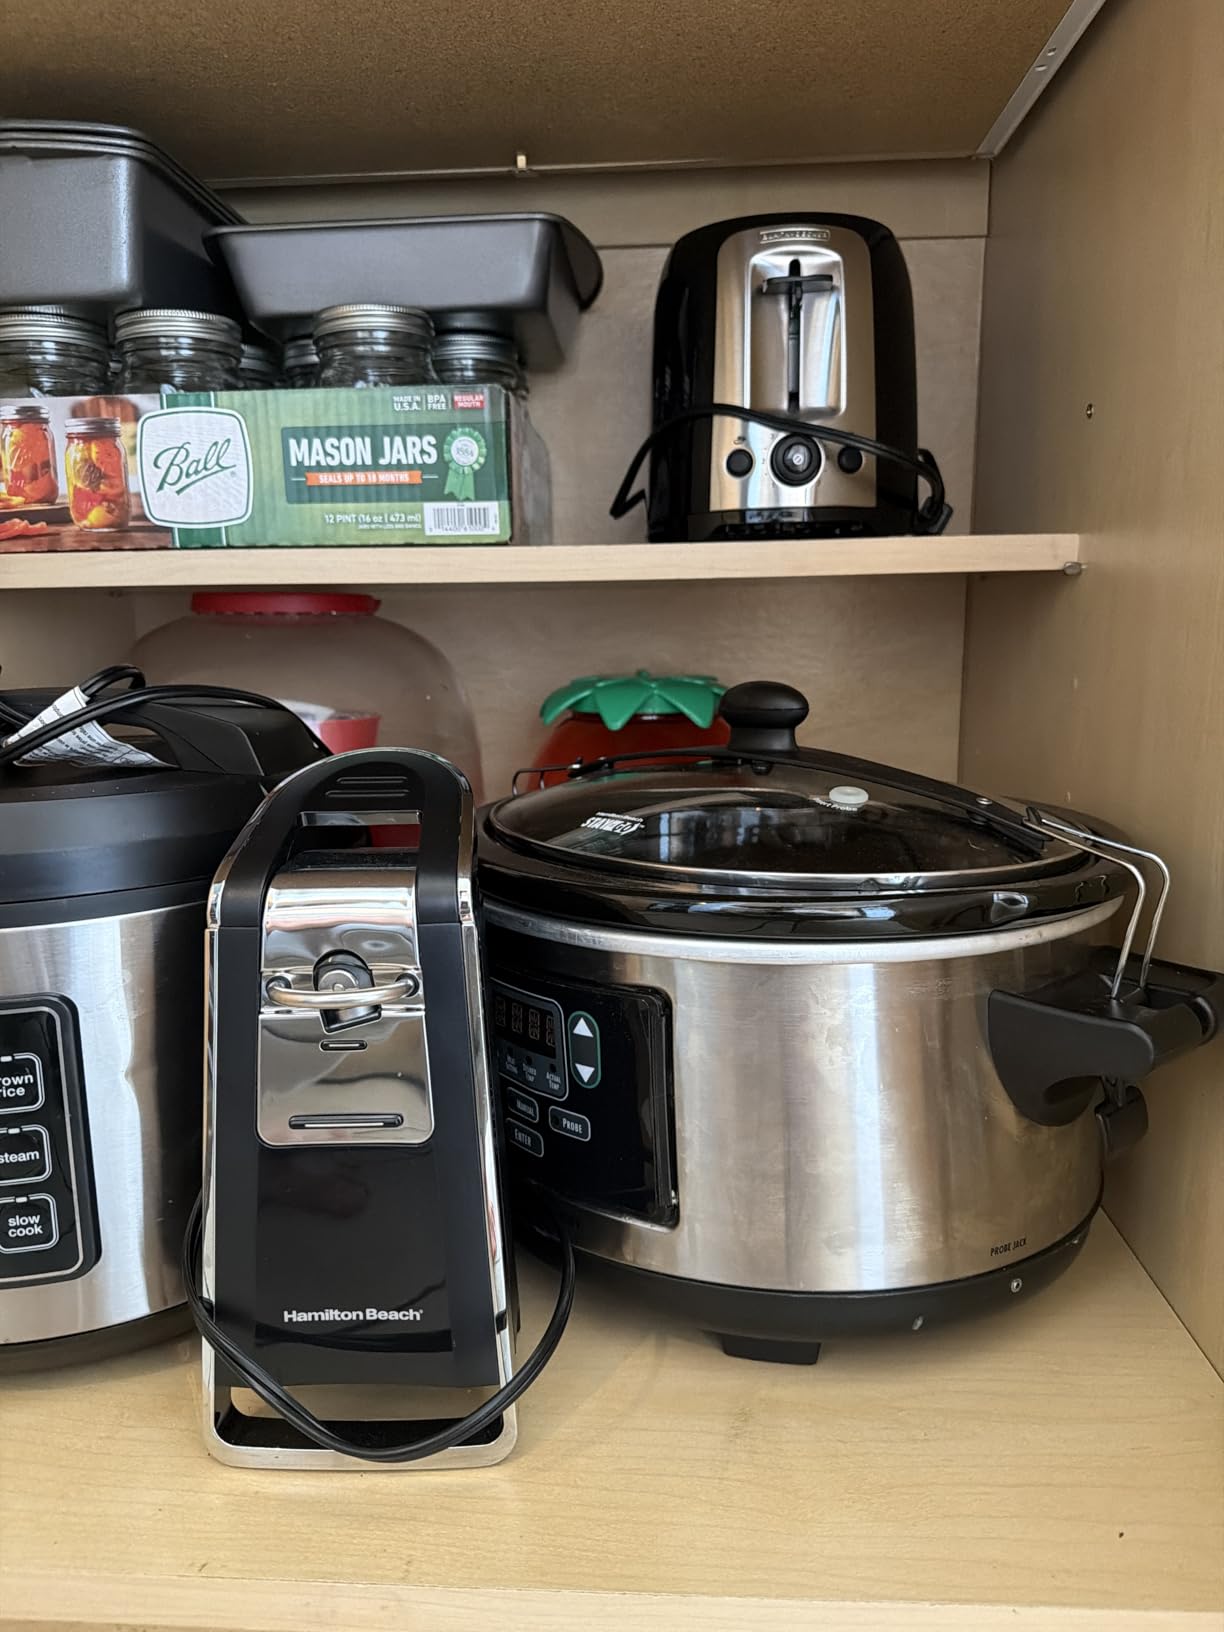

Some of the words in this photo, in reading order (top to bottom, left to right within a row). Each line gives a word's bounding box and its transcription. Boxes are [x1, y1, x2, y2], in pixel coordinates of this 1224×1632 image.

[427, 394, 446, 403] BPA
[393, 402, 422, 411] U.S.A.
[288, 436, 373, 467] MASON
[378, 435, 438, 465] JARS
[153, 438, 236, 495] Ball
[319, 473, 342, 484] SEALS
[343, 473, 354, 483] UP
[356, 473, 366, 483] TO
[378, 472, 410, 483] MONTHS
[324, 513, 335, 524] 12
[336, 513, 357, 524] PINT
[358, 513, 372, 524] (16
[373, 515, 383, 523] oz
[389, 513, 405, 523] 473
[0, 1074, 33, 1086] own
[562, 1117, 583, 1134] PROBE
[515, 1128, 532, 1146] ENTER
[0, 1150, 40, 1164] steam
[8, 1214, 41, 1227] slow
[8, 1223, 43, 1238] cook
[990, 1242, 1011, 1257] PROBE
[1012, 1237, 1026, 1250] JACK
[283, 1309, 364, 1323] Hamilton
[366, 1308, 421, 1321] Beach
